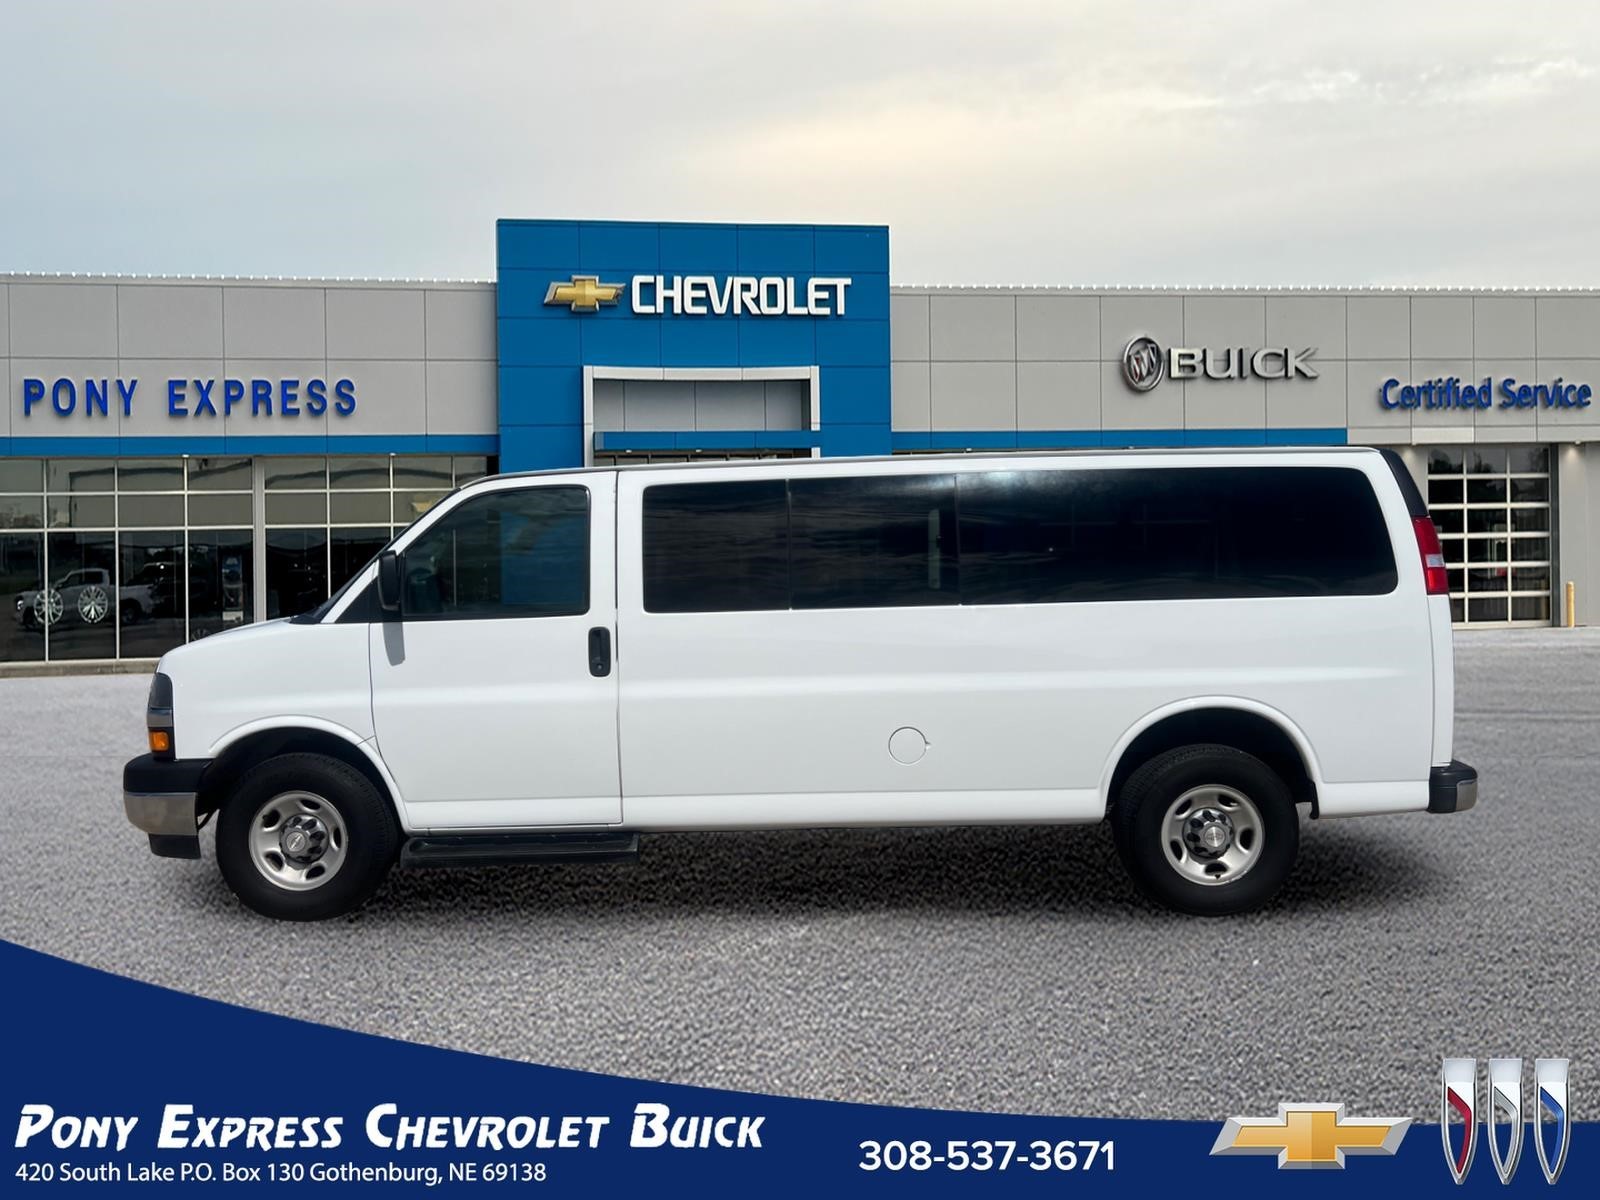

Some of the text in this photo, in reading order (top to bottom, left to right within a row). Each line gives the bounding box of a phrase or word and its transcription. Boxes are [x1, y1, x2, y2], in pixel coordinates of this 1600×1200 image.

[631, 274, 852, 315] CHEVROLET
[1168, 346, 1319, 380] BUICK
[23, 378, 357, 417] PONY EXPRESS
[1380, 377, 1592, 409] Certified Service
